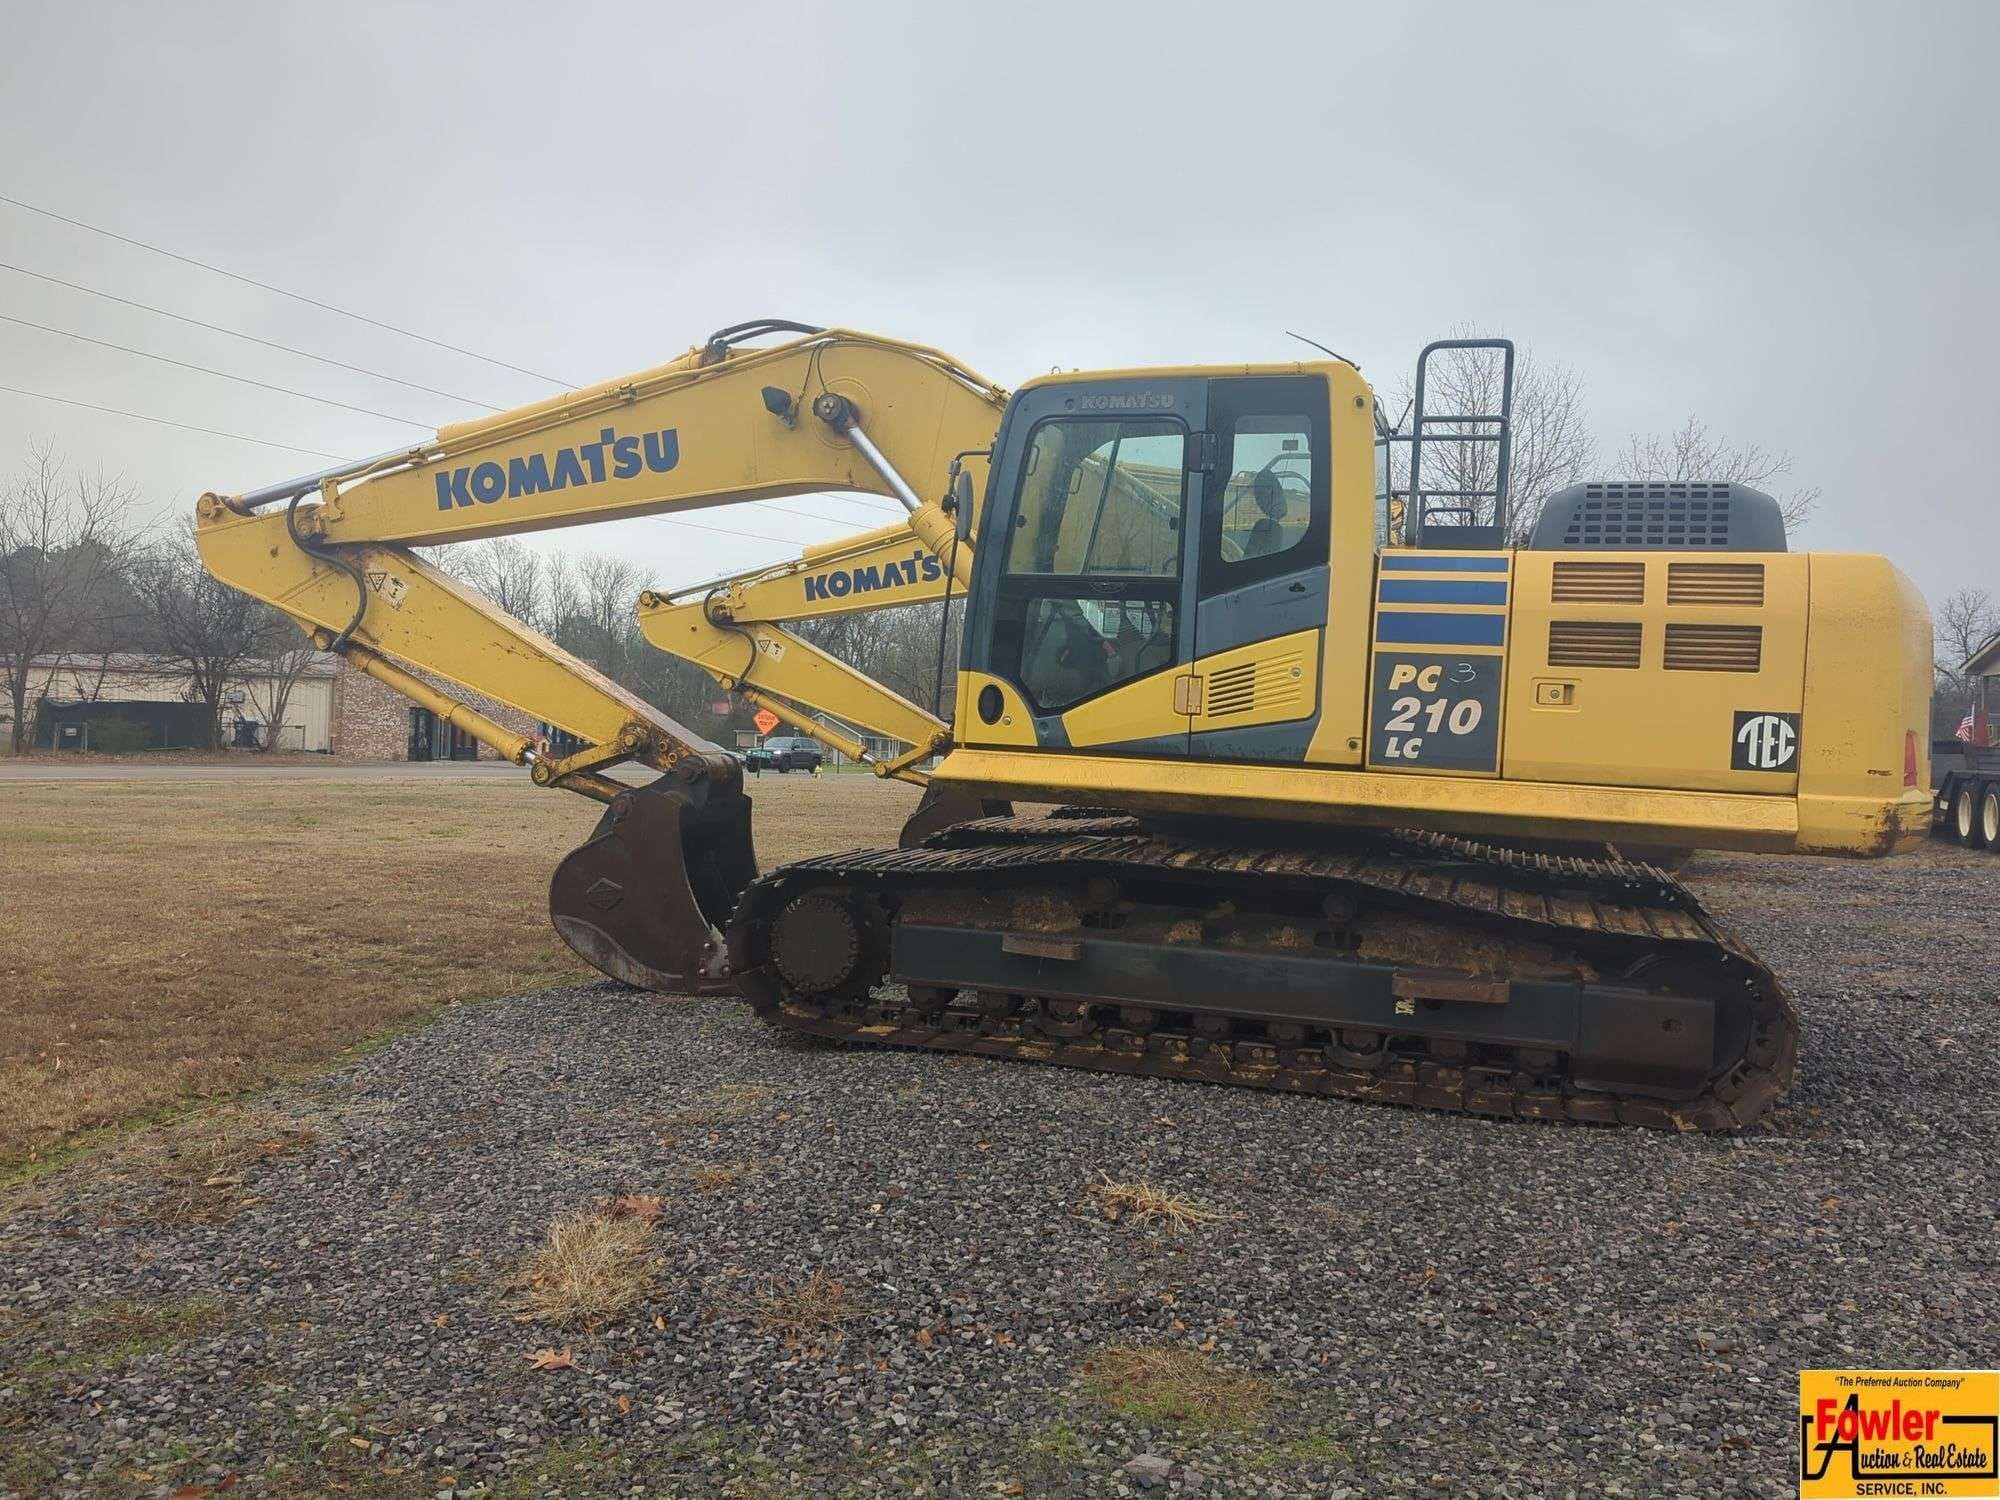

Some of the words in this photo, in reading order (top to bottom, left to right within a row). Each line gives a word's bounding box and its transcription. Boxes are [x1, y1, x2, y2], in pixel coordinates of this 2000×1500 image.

[1081, 391, 1174, 409] KOMATSU
[435, 427, 680, 511] KOMATSU
[1388, 664, 1442, 692] PC
[1449, 662, 1476, 683] 3
[1384, 696, 1482, 735] 210
[1384, 736, 1422, 759] LC
